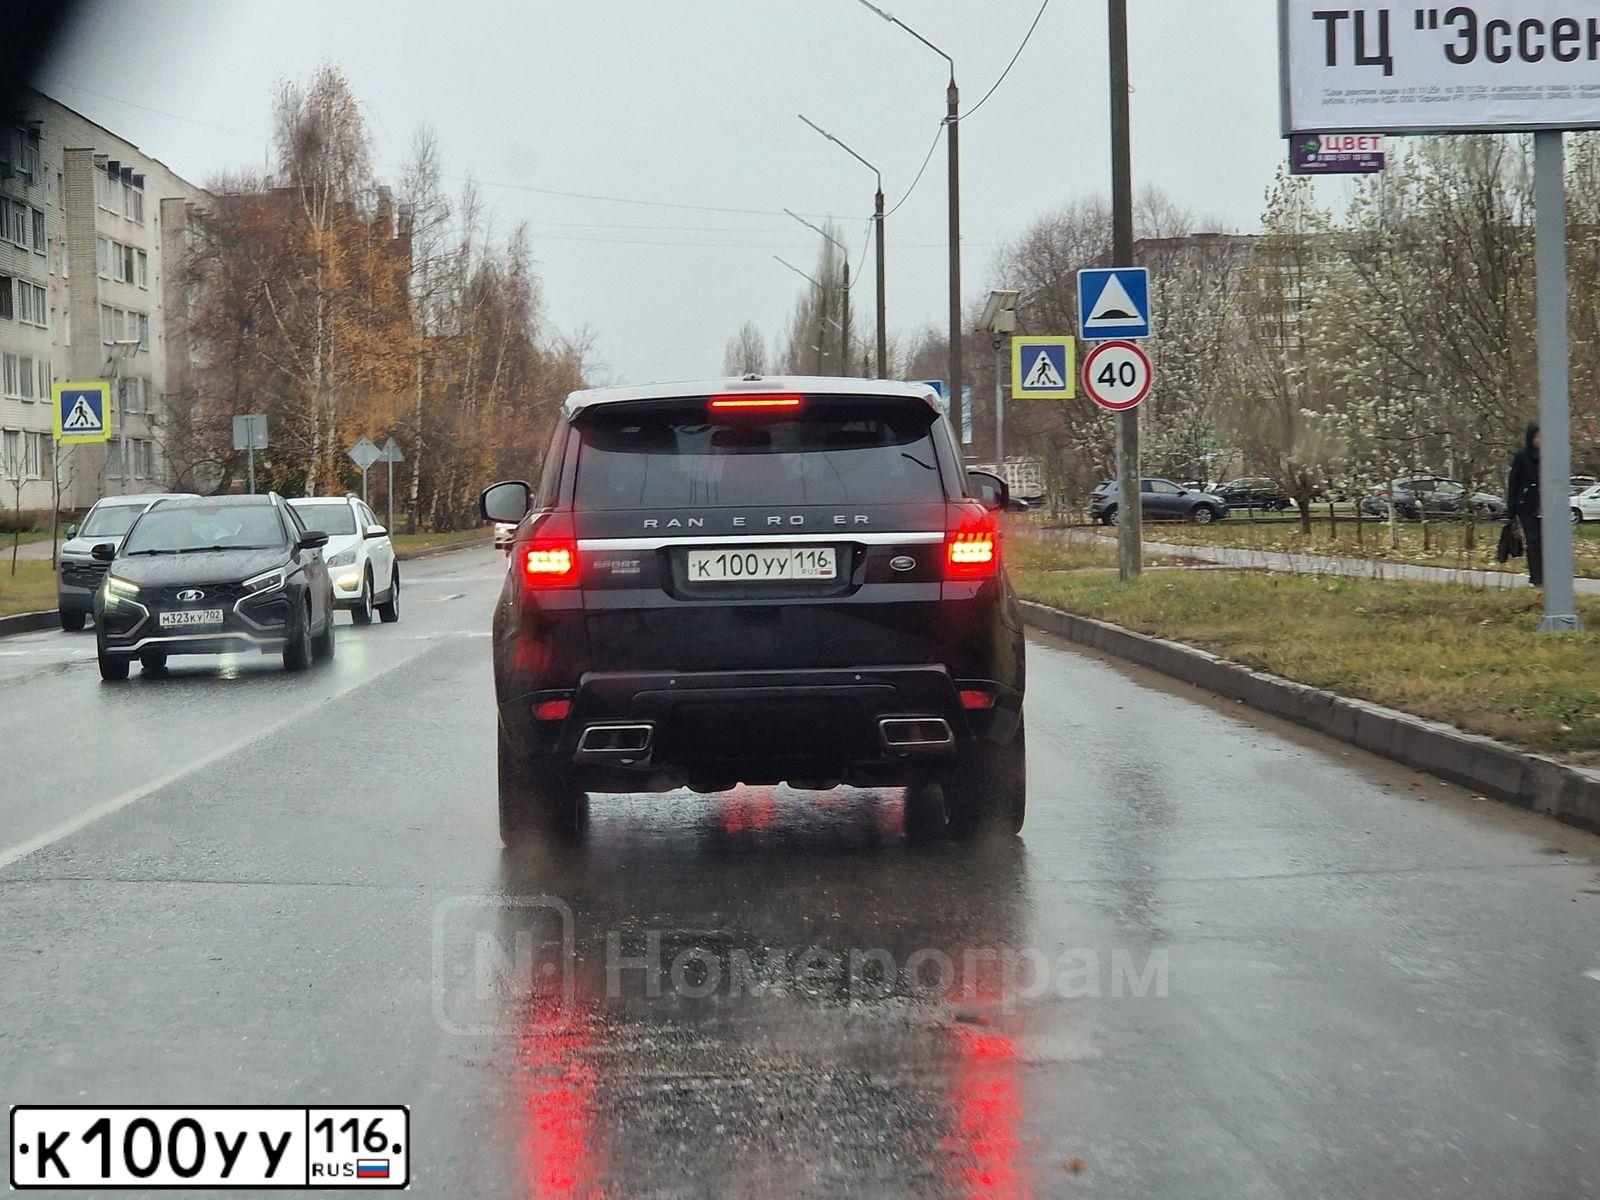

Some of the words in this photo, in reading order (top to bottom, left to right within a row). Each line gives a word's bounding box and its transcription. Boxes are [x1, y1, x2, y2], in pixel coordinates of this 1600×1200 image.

[1312, 9, 1393, 76] ТЦ
[1325, 136, 1380, 153] ЦВЕТ
[1097, 361, 1136, 388] 40
[794, 551, 828, 569] 116
[205, 610, 221, 620] 702
